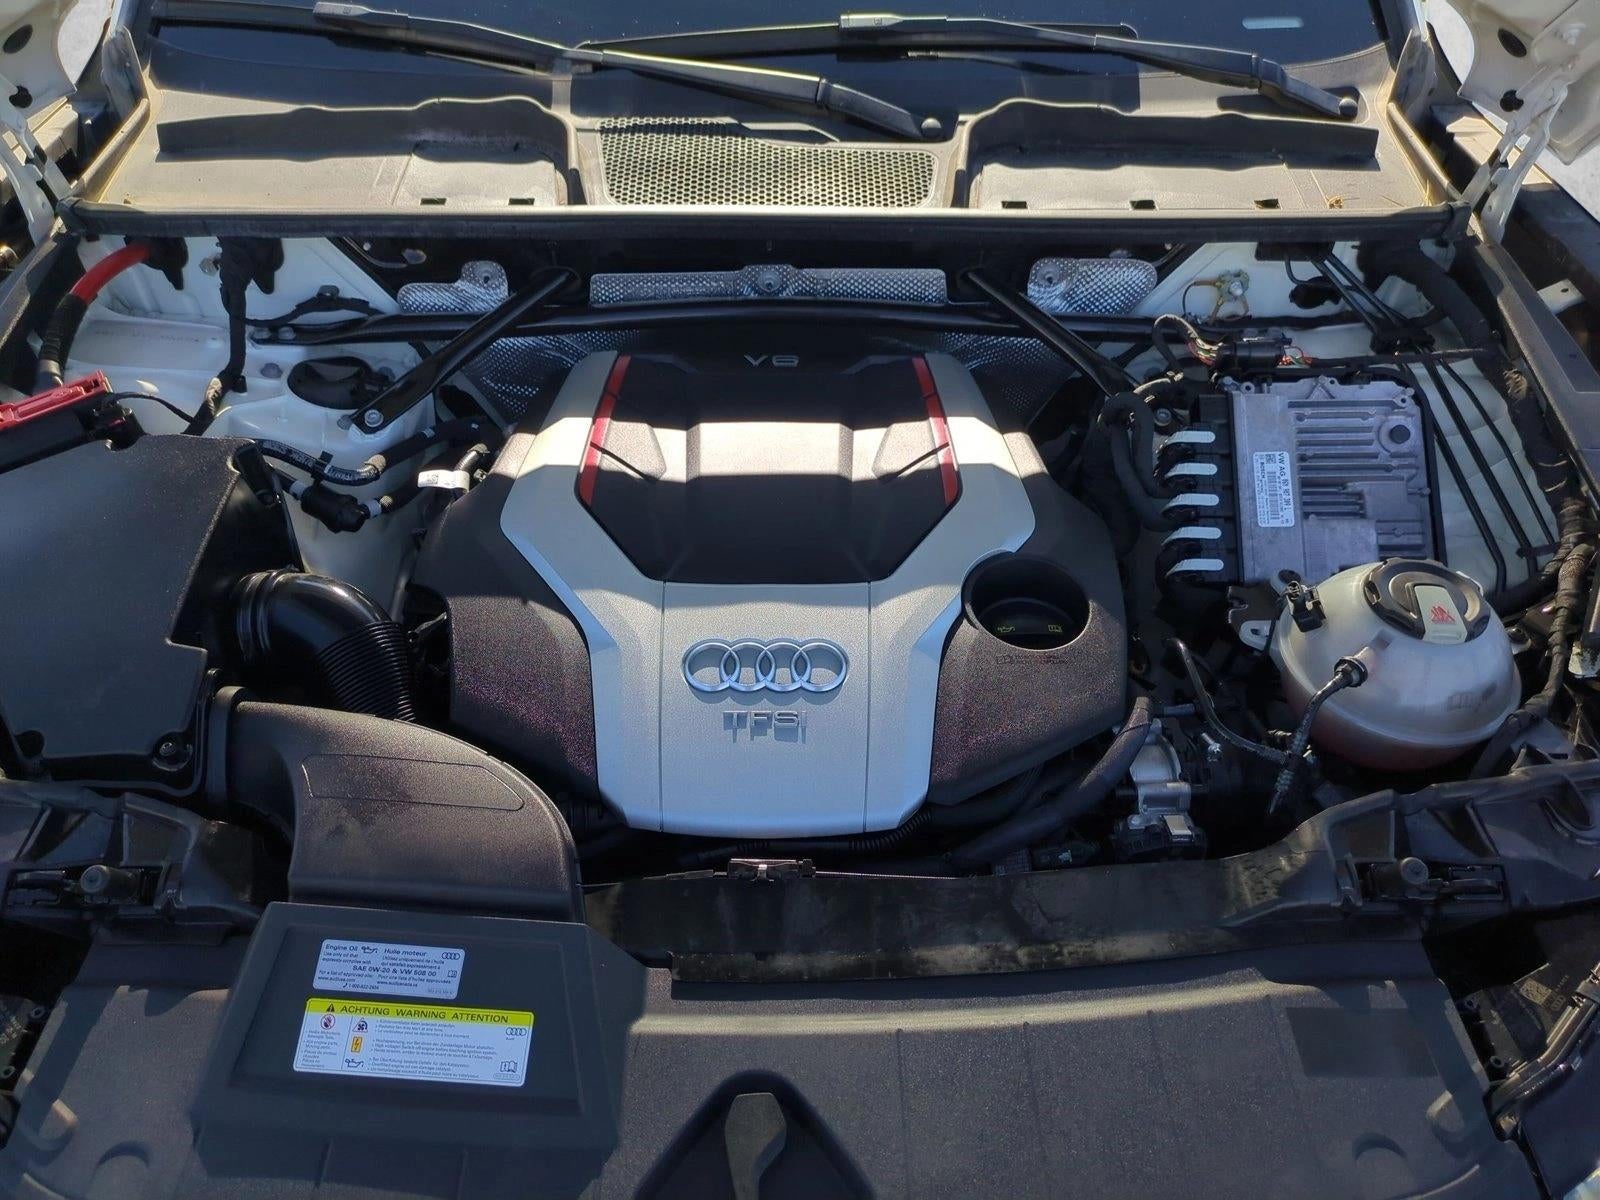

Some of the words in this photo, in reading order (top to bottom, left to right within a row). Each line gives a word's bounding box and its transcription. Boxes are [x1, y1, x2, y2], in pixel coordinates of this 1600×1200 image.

[743, 354, 800, 368] V6
[1278, 452, 1286, 464] VW
[1280, 465, 1286, 477] AG
[722, 710, 808, 728] TFSI
[325, 943, 348, 951] Engine
[368, 966, 391, 974] 0W-20
[340, 1005, 390, 1016] ACHTUNG
[396, 1009, 446, 1020] WARNING
[451, 1012, 509, 1024] ATTENTION
